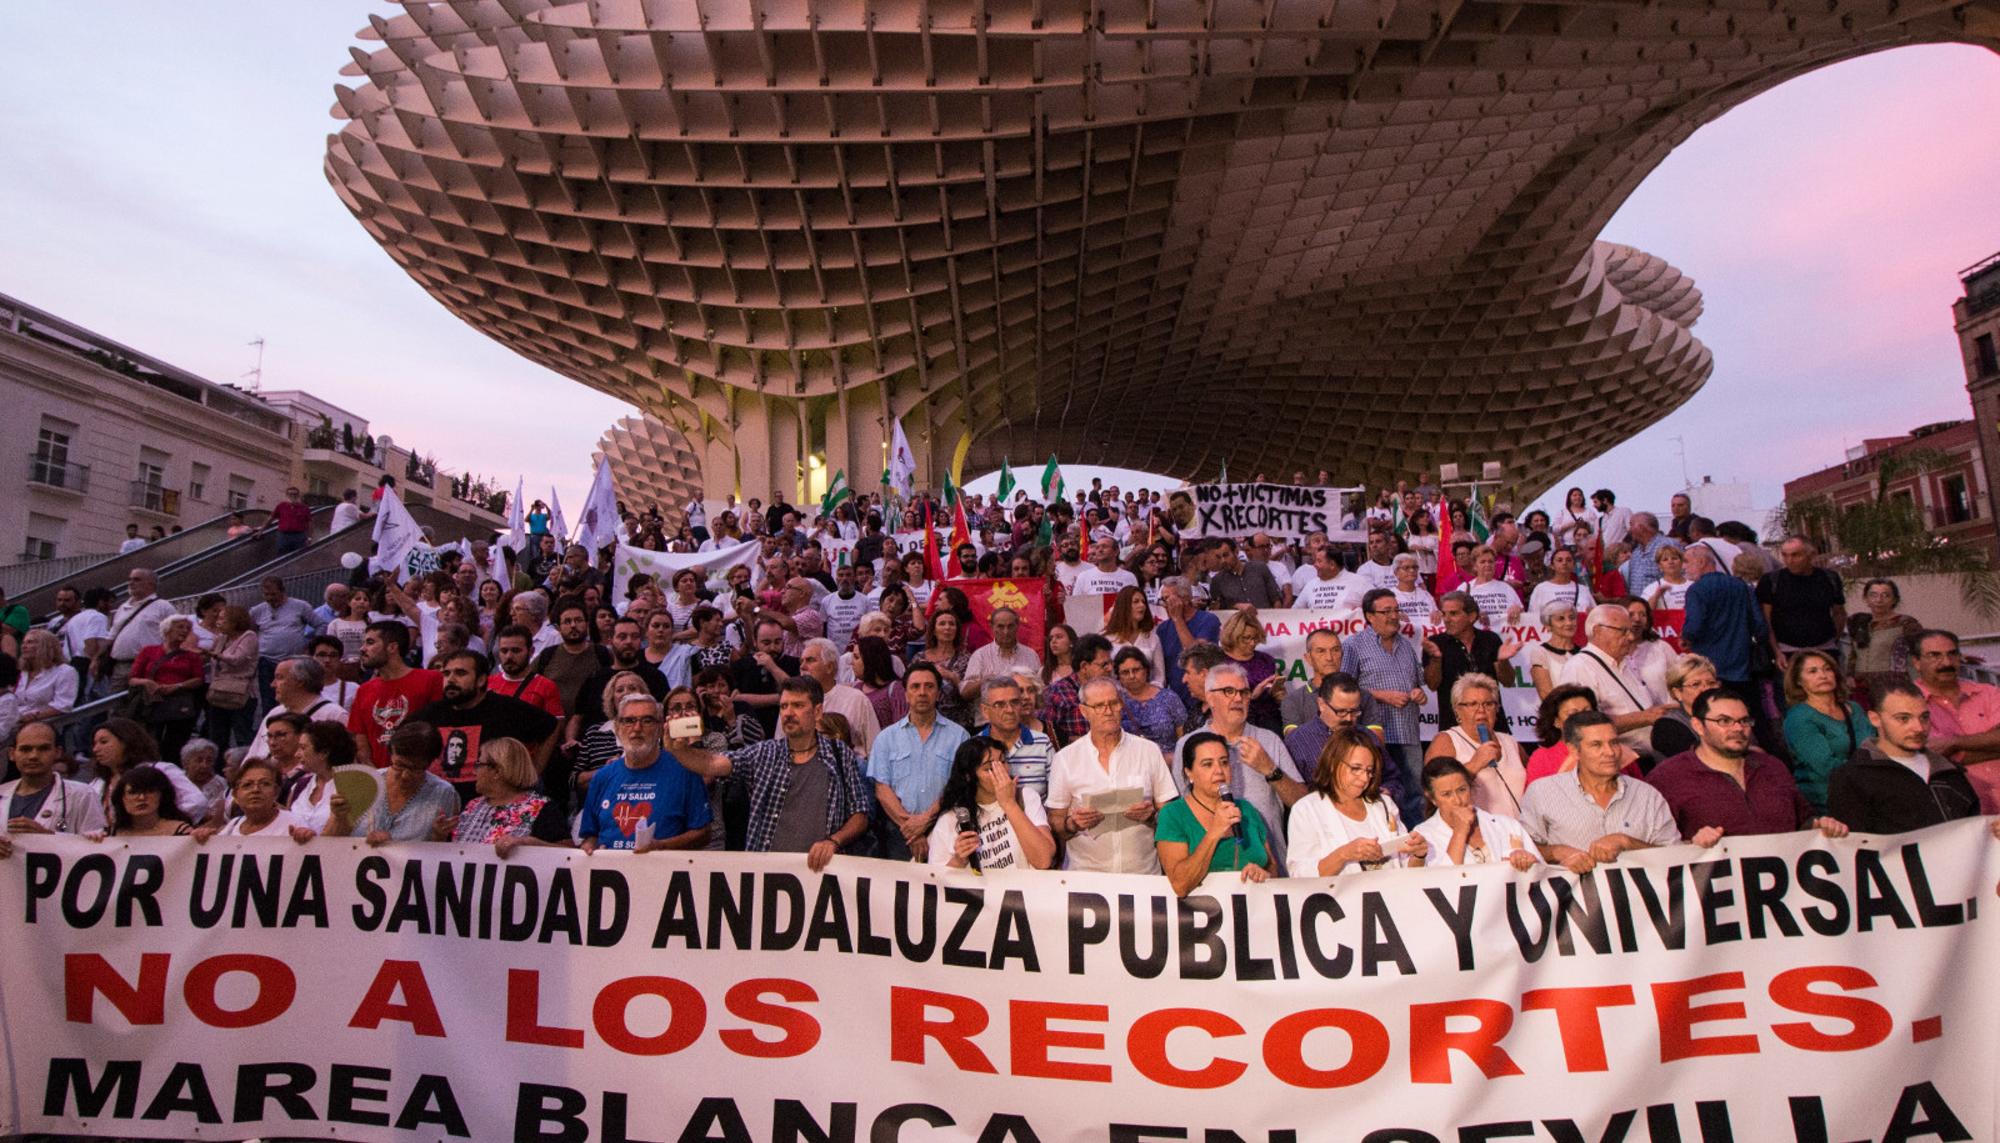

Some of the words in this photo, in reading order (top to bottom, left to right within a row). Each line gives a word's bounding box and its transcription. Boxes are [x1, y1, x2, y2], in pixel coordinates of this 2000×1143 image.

[1299, 617, 1367, 635] MÉDIC
[1519, 716, 1538, 727] HO
[25, 853, 164, 929] POR
[188, 854, 329, 929] UNA
[351, 857, 630, 949] SANIDAD
[652, 871, 1041, 973] ANDALUZA
[1068, 892, 1417, 981] PUBLICA
[1424, 885, 1478, 971] Y
[1506, 843, 1978, 963] UNIVERSAL.
[64, 953, 297, 1029] NO
[347, 959, 447, 1038] A
[505, 969, 822, 1058] LOS
[890, 965, 1942, 1090] RECORTES.
[42, 1058, 471, 1138] MAREA
